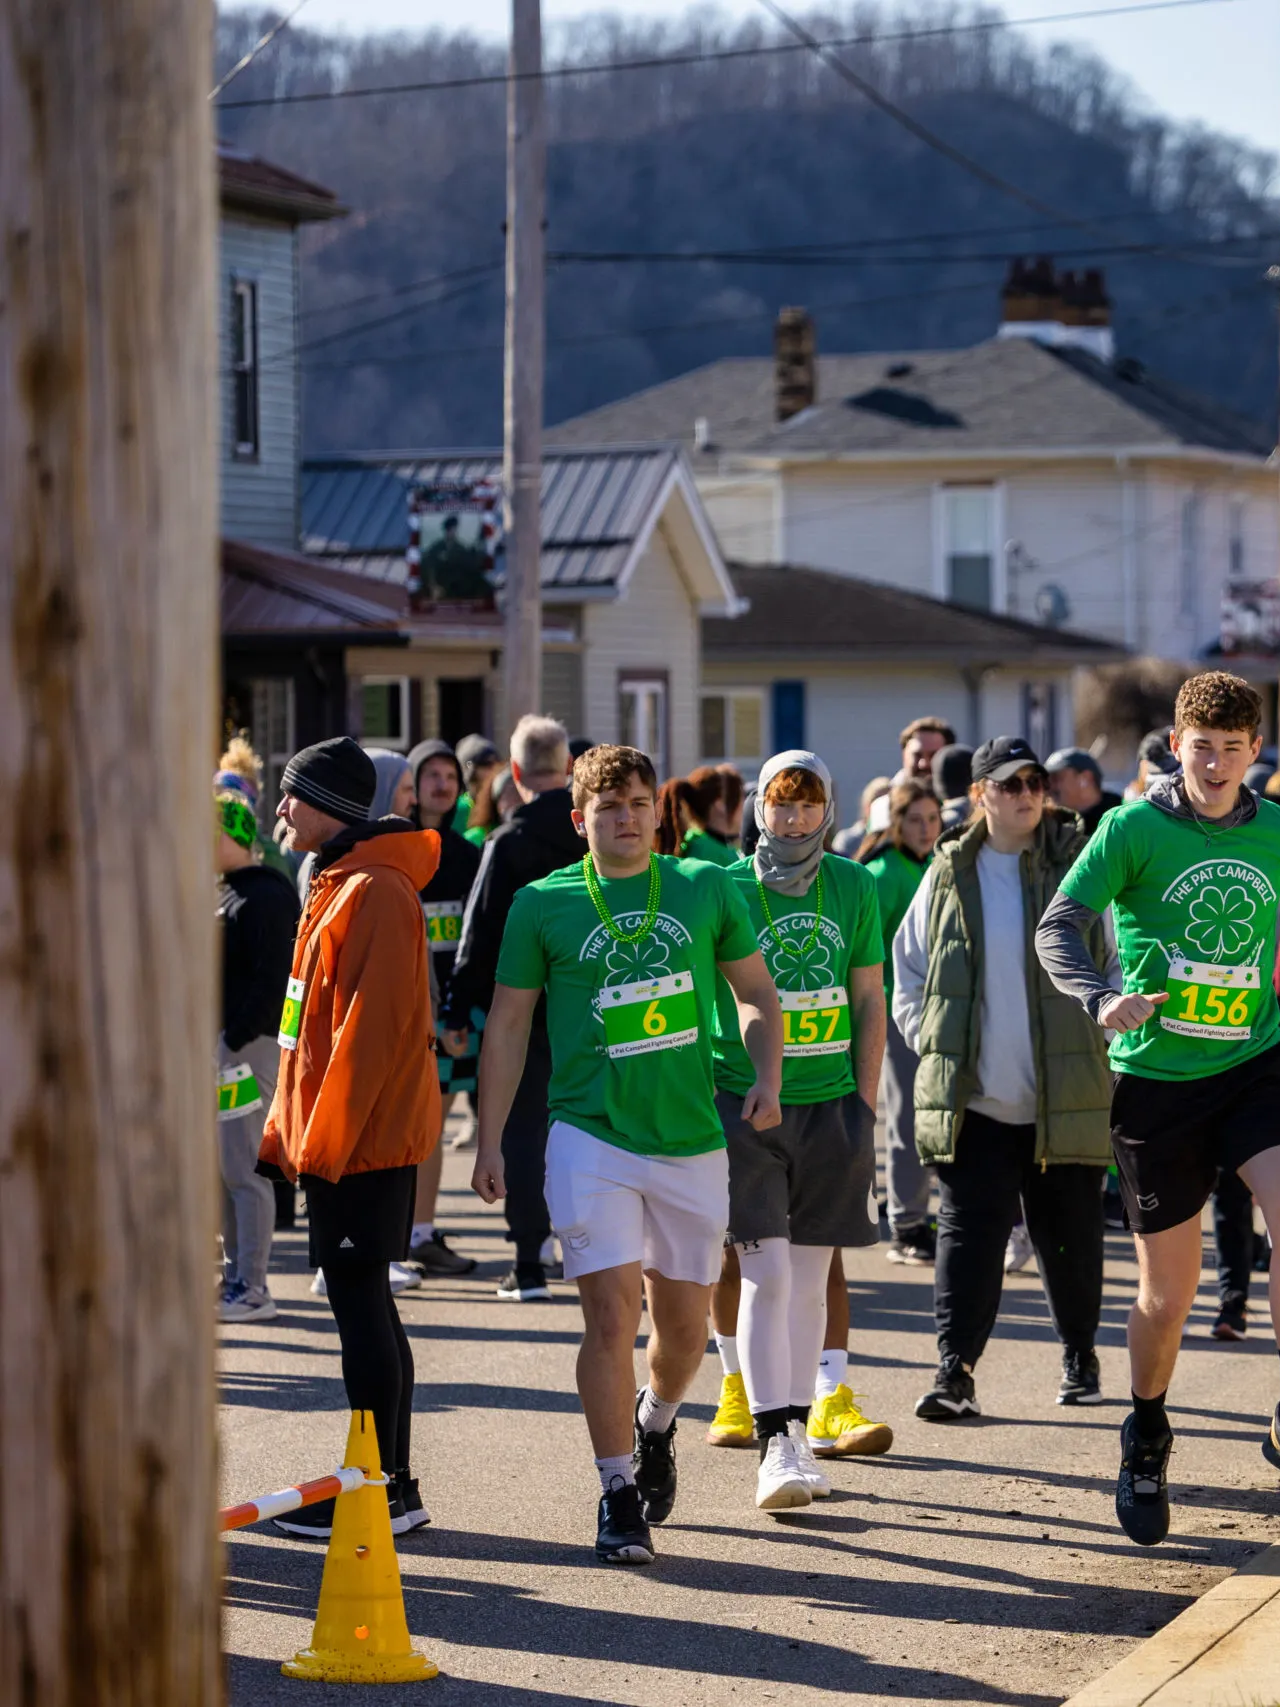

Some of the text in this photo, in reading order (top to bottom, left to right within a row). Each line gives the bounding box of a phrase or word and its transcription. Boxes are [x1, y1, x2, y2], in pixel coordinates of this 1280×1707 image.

[1169, 865, 1272, 907] THE PAT CAMPBELL
[586, 935, 606, 959] THE
[601, 920, 623, 940] PT
[760, 936, 774, 955] HE
[769, 921, 789, 940] AT
[643, 1000, 667, 1036] 6
[1178, 985, 1250, 1026] 156
[782, 1008, 840, 1043] 157
[1176, 1024, 1203, 1034] Campbell
[1204, 1028, 1225, 1037] Fighting
[625, 1042, 651, 1053] Campbell
[651, 1038, 673, 1048] Fighting
[216, 1082, 238, 1108] 7
